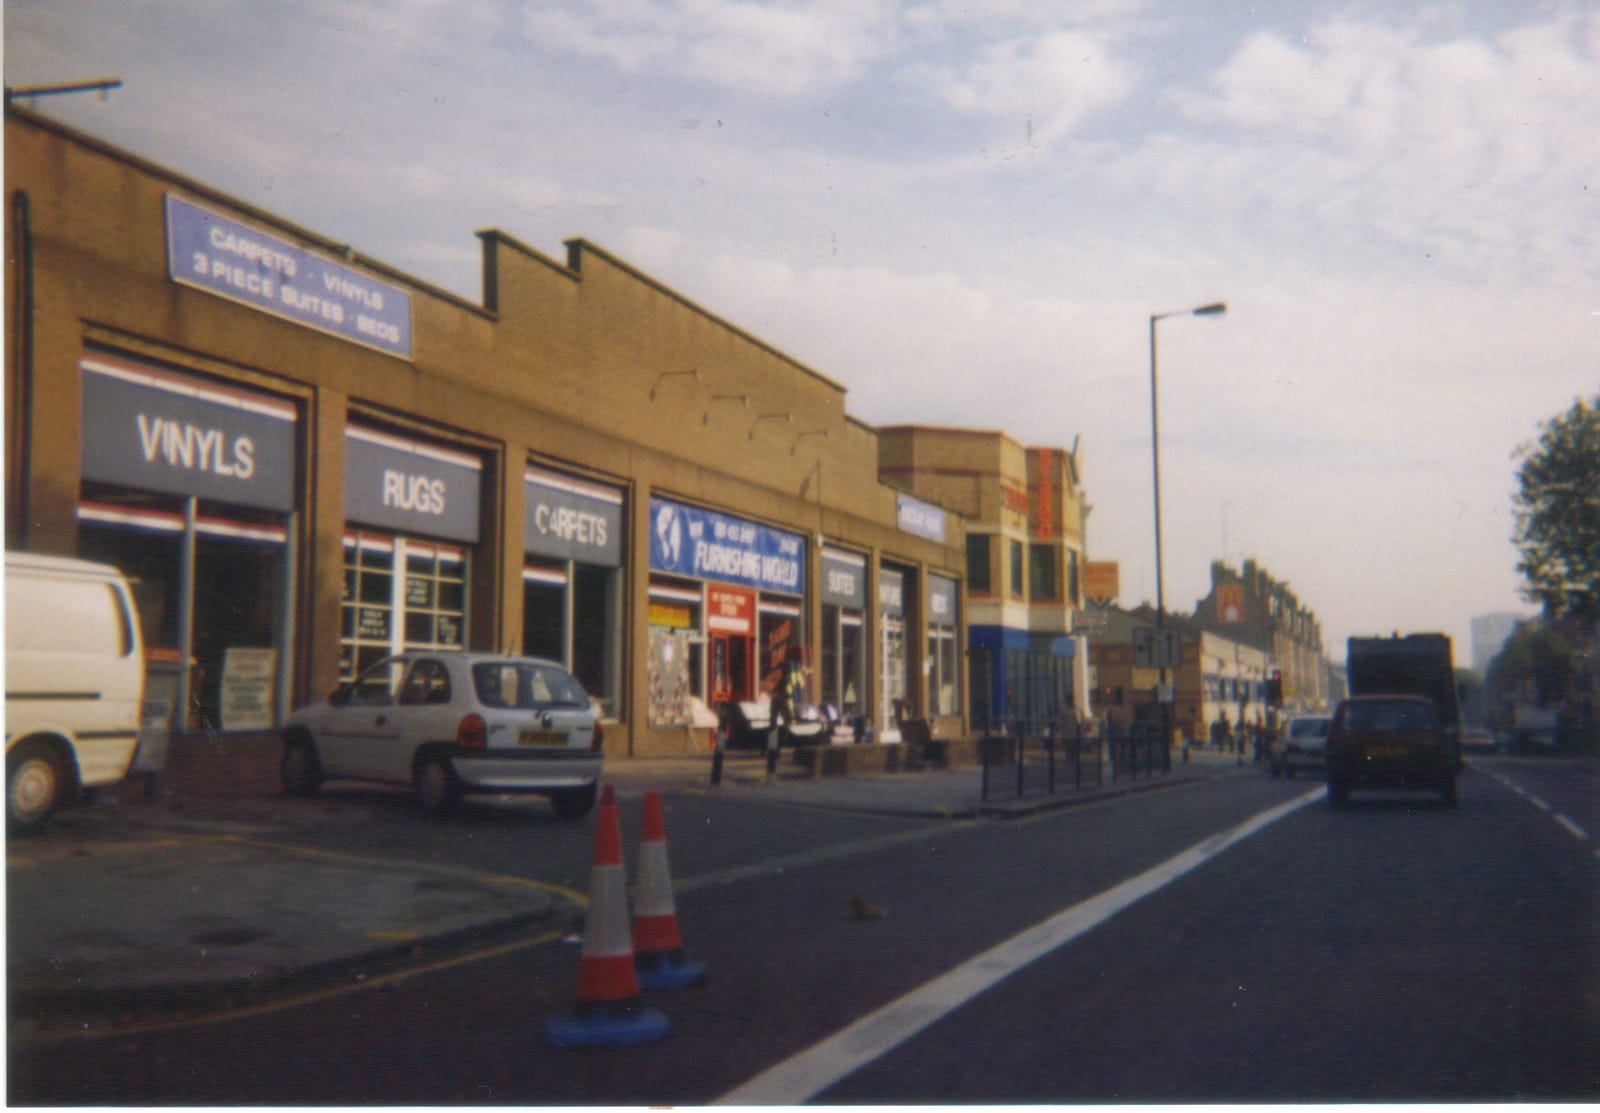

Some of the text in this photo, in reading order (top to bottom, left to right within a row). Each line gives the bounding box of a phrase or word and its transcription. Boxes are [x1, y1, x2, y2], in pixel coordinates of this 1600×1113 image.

[210, 226, 385, 311] CARPETS VINYLS
[193, 253, 401, 344] 3 PIECE SUITES BEDS
[137, 413, 255, 480] VINYLS
[383, 469, 446, 515] RUGS
[535, 503, 608, 547] CARPETS
[762, 555, 798, 587] WORLD
